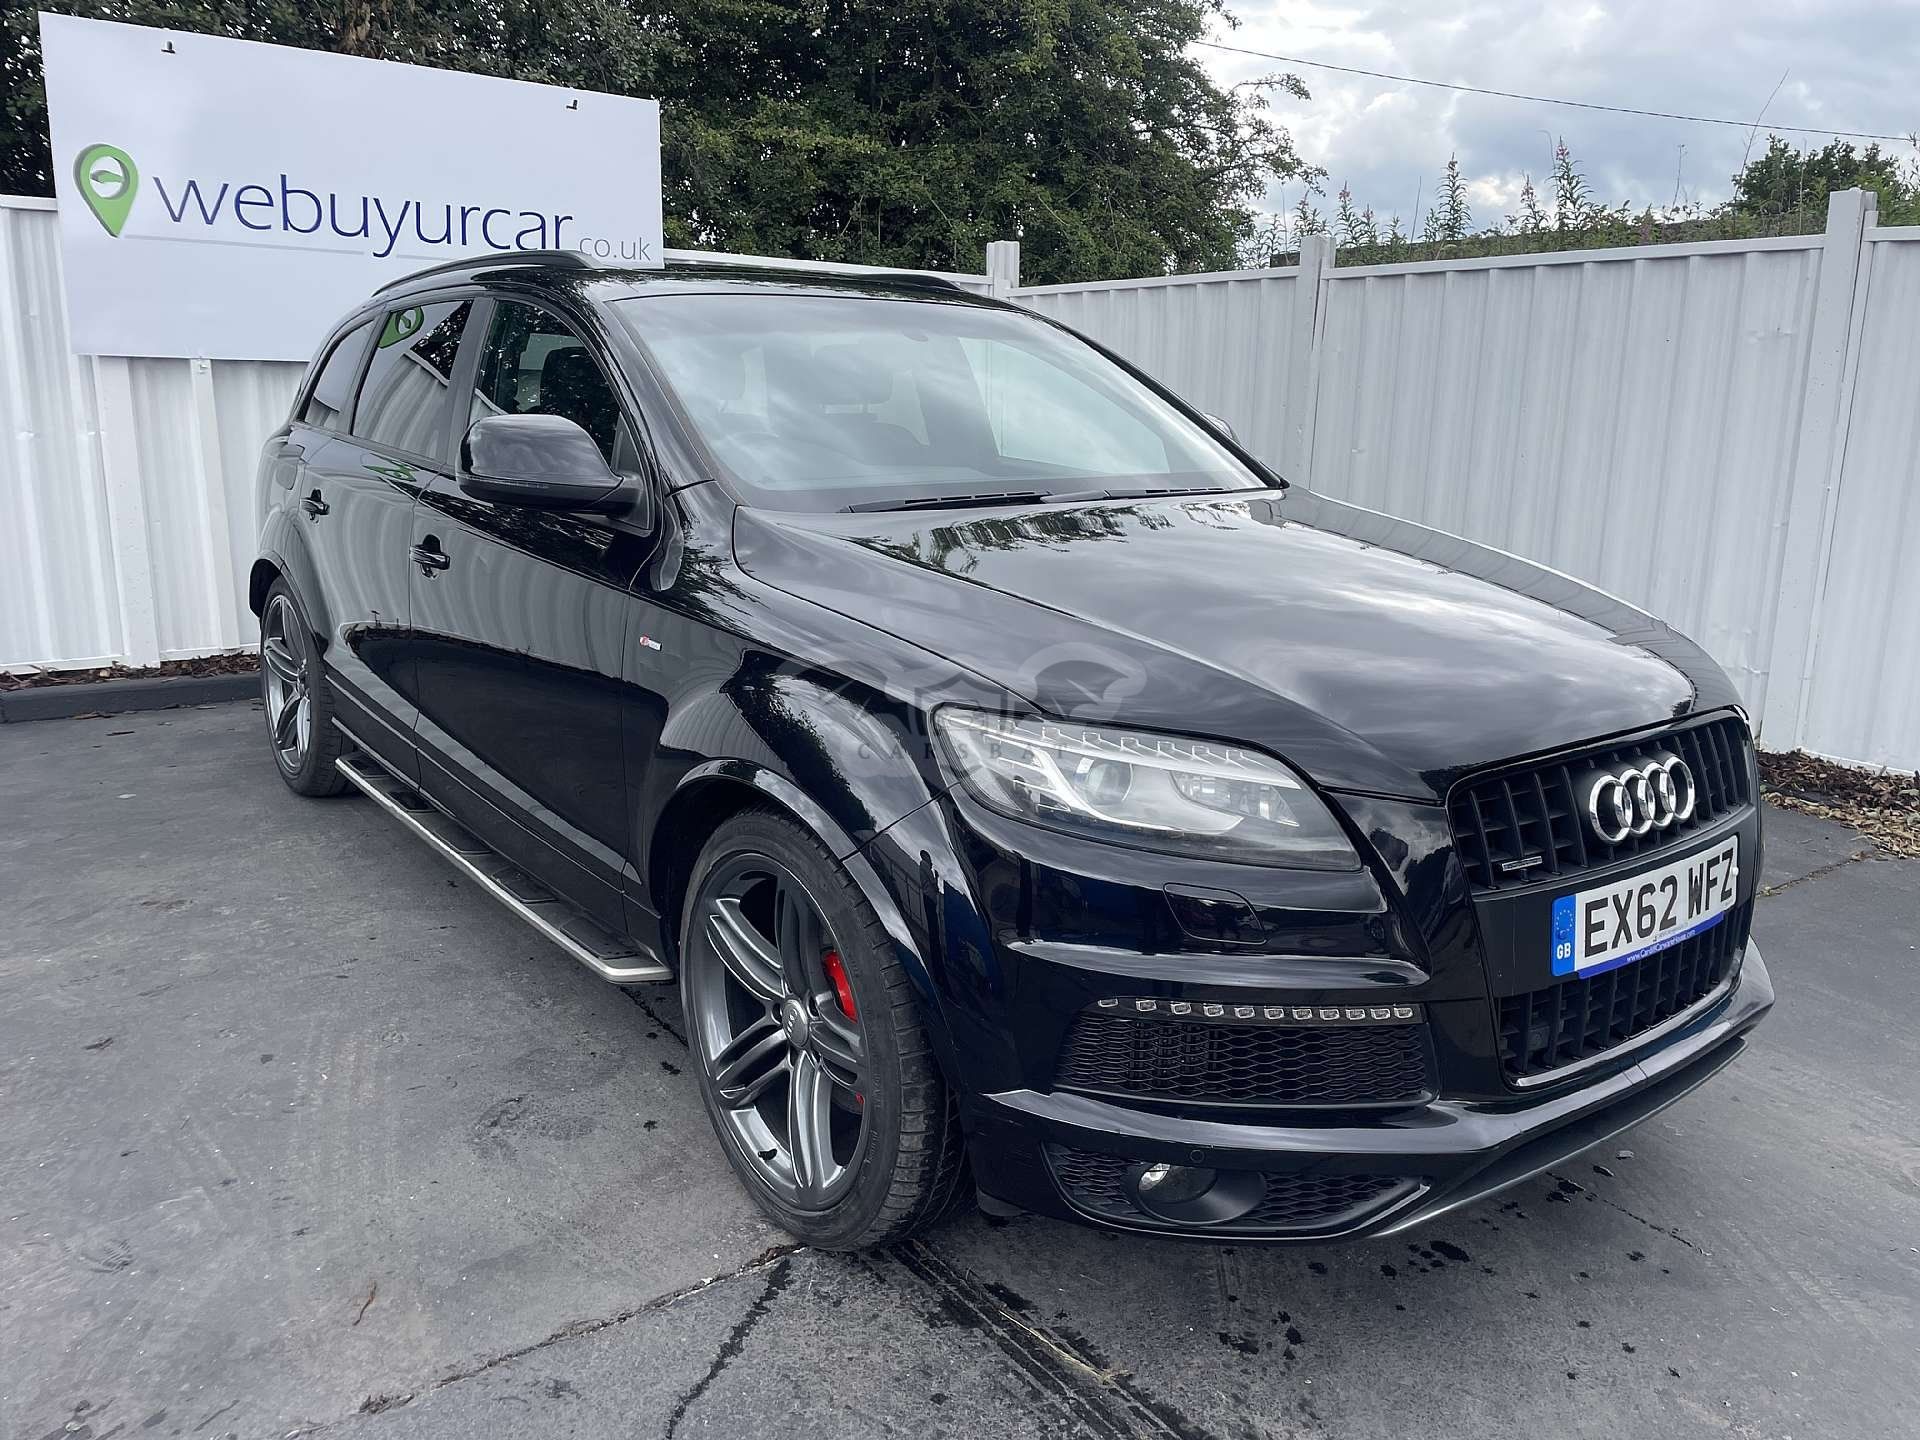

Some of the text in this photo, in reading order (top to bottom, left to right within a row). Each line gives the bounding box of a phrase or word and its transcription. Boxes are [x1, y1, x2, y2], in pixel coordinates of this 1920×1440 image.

[1584, 847, 1734, 958] EX62 WFZ
[1556, 942, 1571, 960] GB
